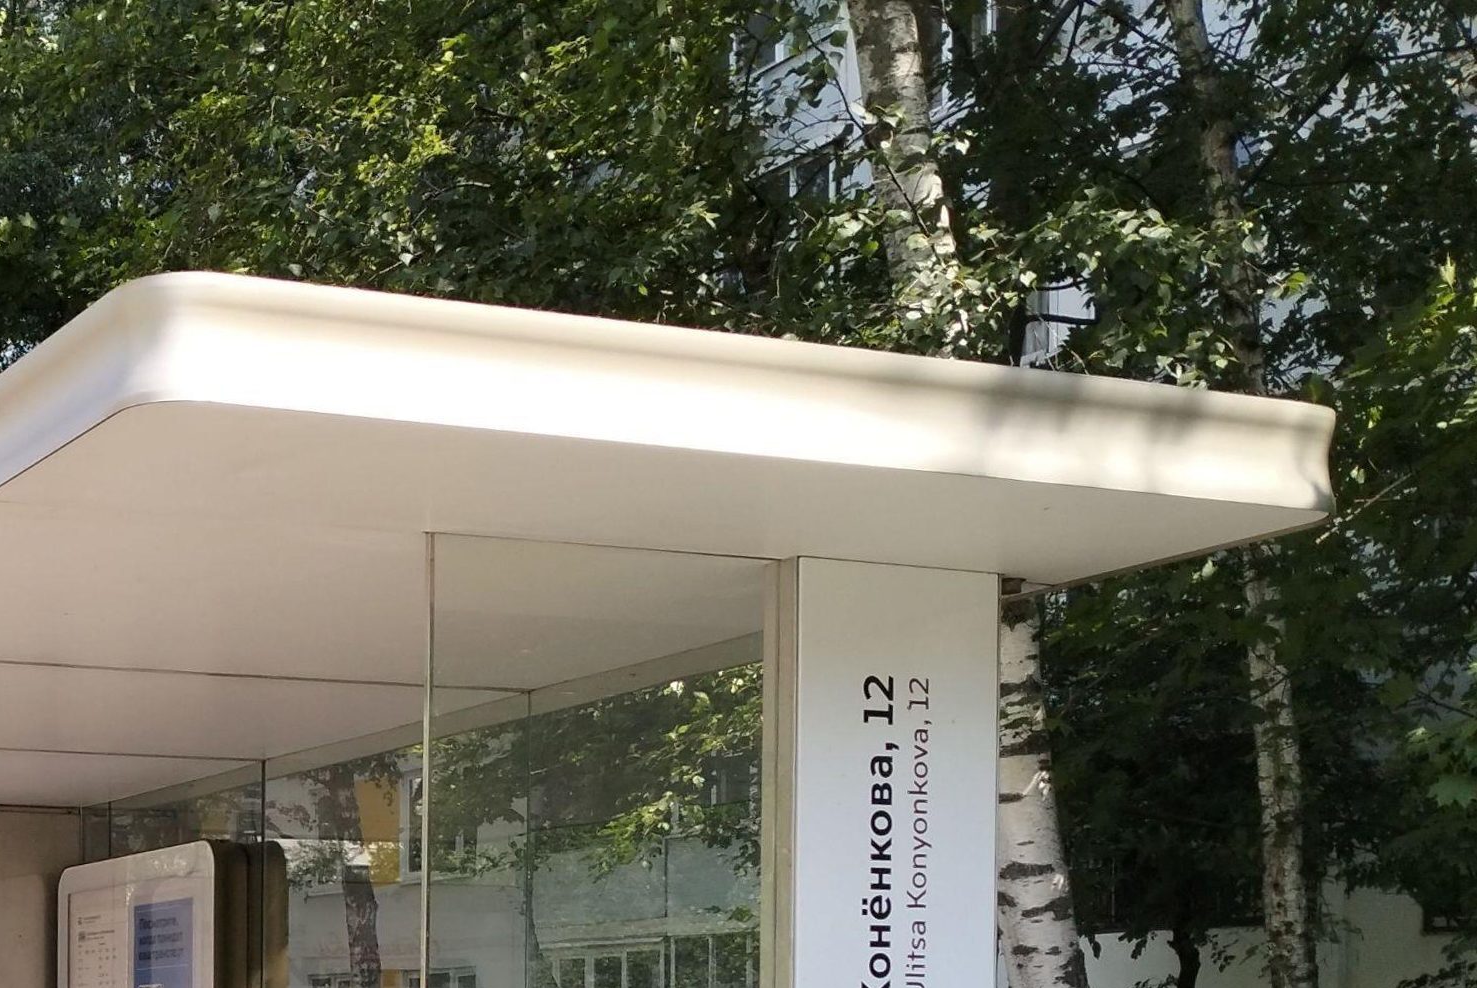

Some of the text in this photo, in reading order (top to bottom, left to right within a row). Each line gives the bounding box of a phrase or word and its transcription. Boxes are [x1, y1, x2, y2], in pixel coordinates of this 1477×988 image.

[863, 675, 894, 726] 12
[909, 677, 929, 711] 12
[907, 719, 932, 908] Konyonkova,
